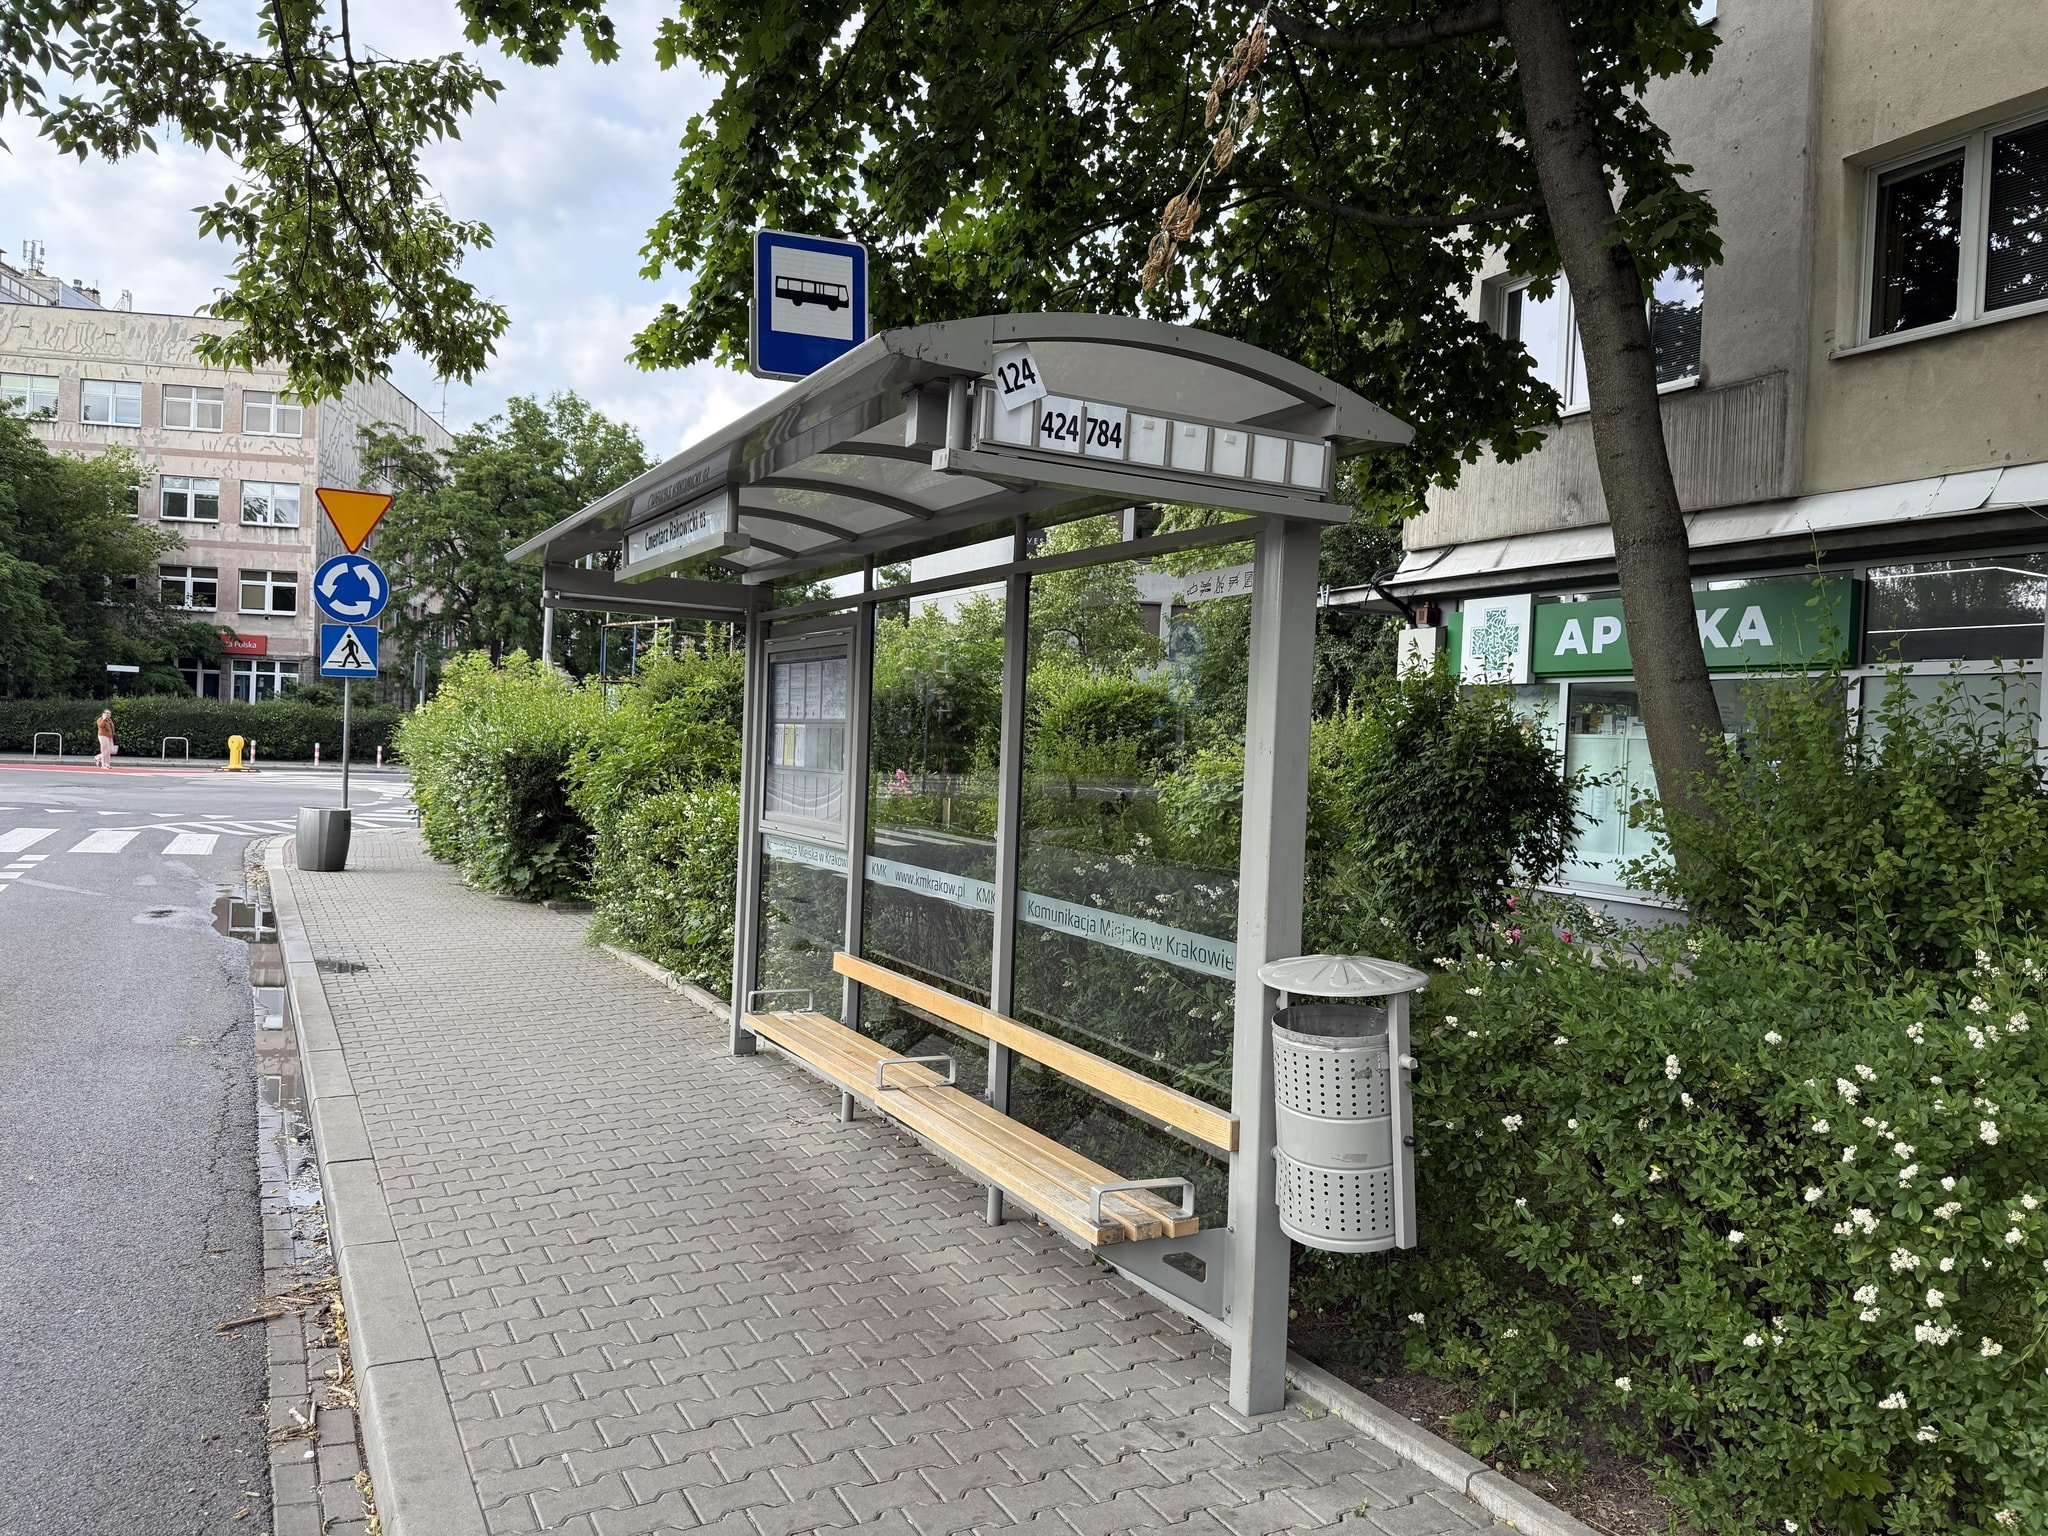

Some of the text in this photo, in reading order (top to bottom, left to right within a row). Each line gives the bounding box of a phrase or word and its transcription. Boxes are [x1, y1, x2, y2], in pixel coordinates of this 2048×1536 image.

[997, 357, 1036, 395] 124
[1040, 411, 1122, 449] 424 784
[644, 526, 669, 551] Cmentarz
[669, 509, 698, 541] Rakowicki
[1553, 605, 1774, 656] APKA
[871, 861, 888, 879] KMK
[894, 870, 966, 901] www.kmkrakow.pl
[1027, 899, 1234, 972] Komunikacja Miejska w Krakowie
